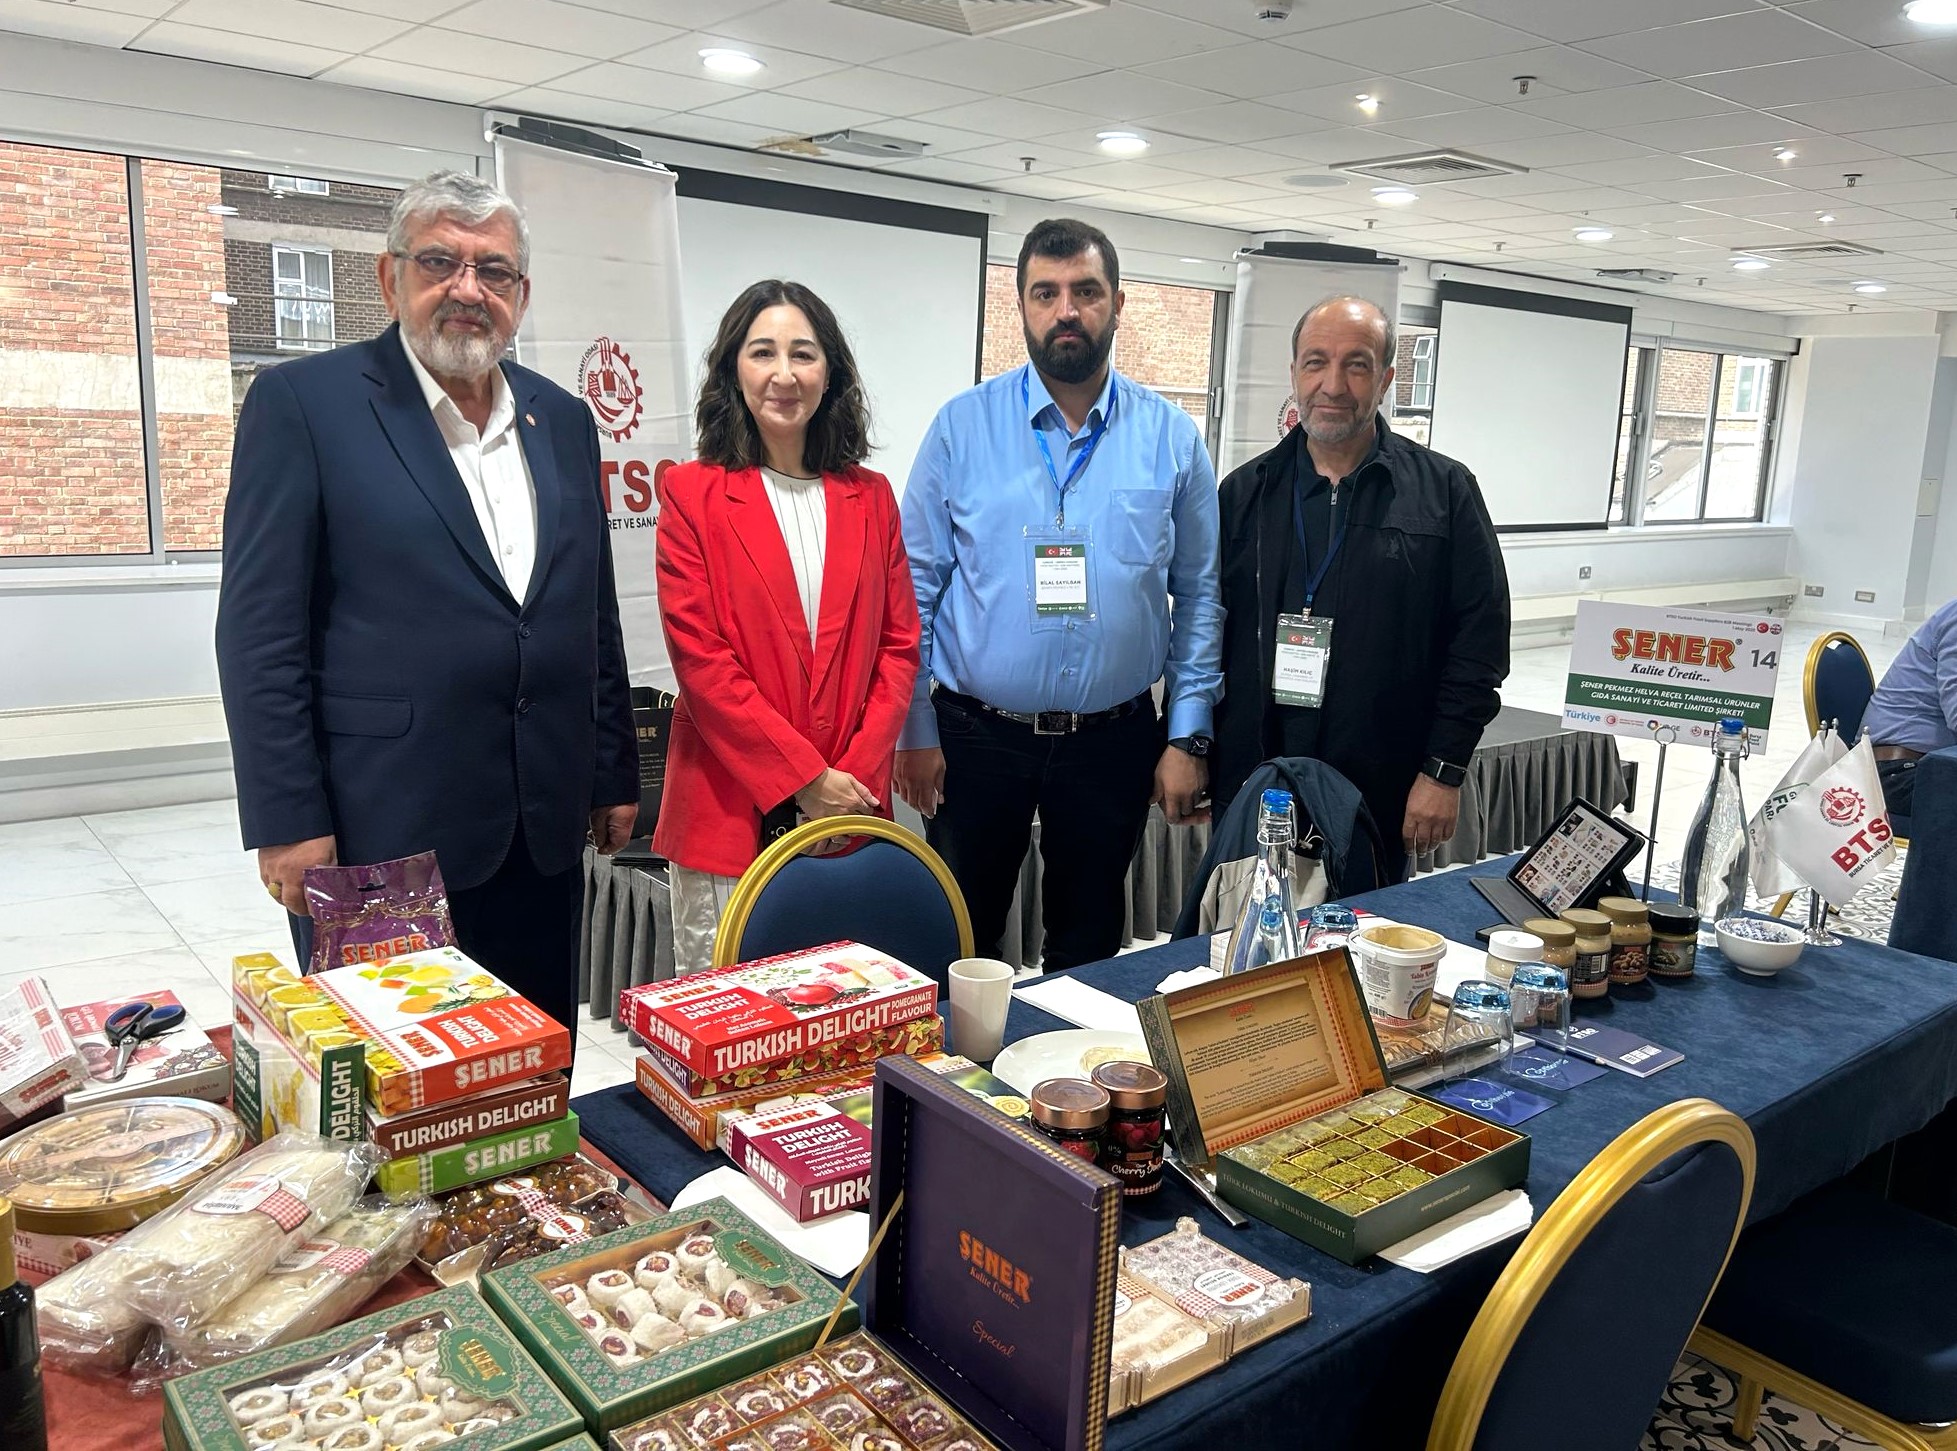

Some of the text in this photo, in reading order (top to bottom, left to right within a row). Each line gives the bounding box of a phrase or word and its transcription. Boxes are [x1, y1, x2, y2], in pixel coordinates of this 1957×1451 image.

[625, 518, 635, 529] VE
[637, 516, 658, 529] SANA
[1611, 628, 1736, 673] ŞENER
[1751, 649, 1778, 670] 14
[1630, 663, 1711, 683] Kalite Üretir...
[1580, 680, 1760, 709] ŞENER PEKMEZ HELVA REÇEL TARIMSAL ÜRÜNLER
[1591, 691, 1744, 717] GIDA SANAYİ VE TİCARET LİMİTED ŞİRKETİ
[1566, 709, 1601, 723] Türkiye
[1831, 814, 1891, 873] BTS
[675, 993, 743, 1014] TURKISH
[685, 999, 750, 1020] DELIGHT
[891, 990, 932, 1010] POMEGRANATE
[891, 1002, 932, 1023] FLAVOUR
[437, 1020, 480, 1049] TURKISH
[456, 1015, 501, 1043] DELIGHT
[714, 1026, 802, 1072] TURKISH
[807, 1002, 891, 1047] DELIGHT
[661, 1051, 687, 1087] DELIGHT
[331, 1060, 352, 1141] DELIGHT
[640, 1069, 701, 1136] TURKISH DELIGHT
[391, 1117, 473, 1151] TURKISH
[478, 1094, 557, 1130] DELIGHT
[771, 1121, 845, 1146] TURKISH
[781, 1129, 852, 1154] DELIGHT
[809, 1157, 844, 1172] Turkish
[813, 1169, 835, 1178] with
[1111, 1164, 1146, 1178] Cherry
[1280, 1202, 1313, 1223] TURKISH
[1313, 1217, 1345, 1239] DELIGHT
[969, 1266, 991, 1288] Kalite
[536, 1310, 583, 1343] Special
[972, 1319, 1016, 1358] Special
